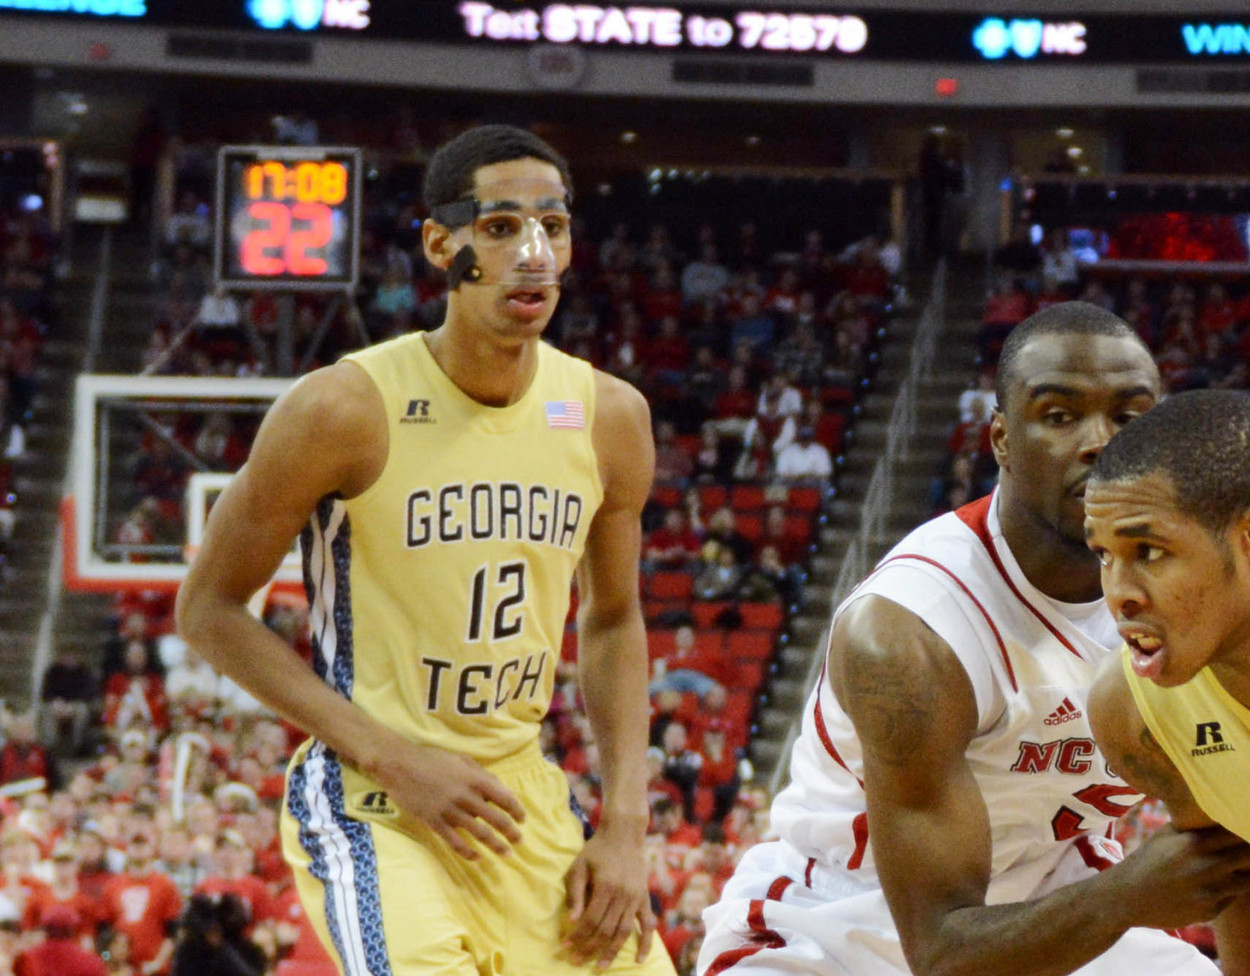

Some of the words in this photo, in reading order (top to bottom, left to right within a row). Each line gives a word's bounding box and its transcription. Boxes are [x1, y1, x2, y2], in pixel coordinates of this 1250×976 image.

[459, 3, 539, 40] Text
[542, 5, 683, 46] STATE
[687, 16, 732, 47] to
[1042, 23, 1086, 54] NC
[245, 161, 348, 205] 17:08
[240, 202, 333, 275] 22
[406, 483, 583, 547] GEORGIA
[467, 561, 525, 641] 12
[421, 652, 548, 715] TECH
[1044, 711, 1082, 726] adidas
[1191, 743, 1236, 757] RUSSELL
